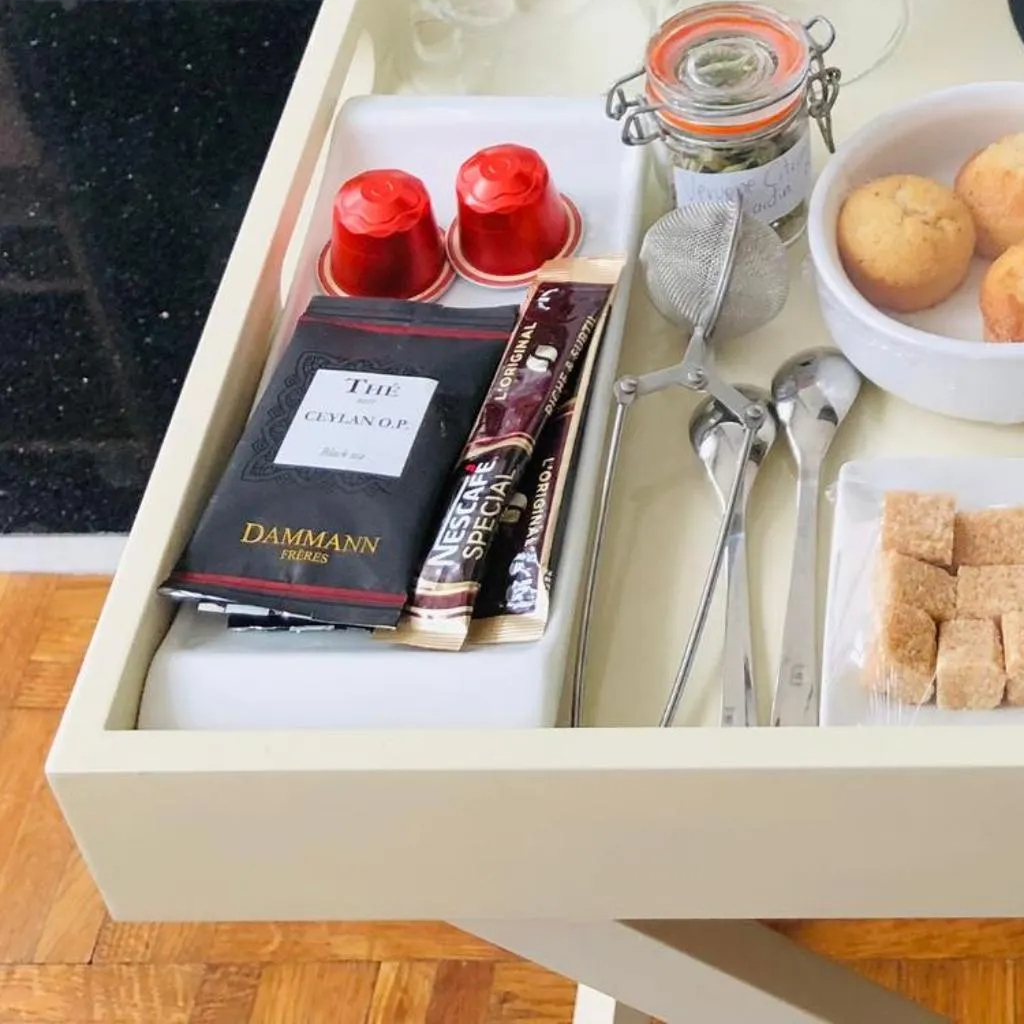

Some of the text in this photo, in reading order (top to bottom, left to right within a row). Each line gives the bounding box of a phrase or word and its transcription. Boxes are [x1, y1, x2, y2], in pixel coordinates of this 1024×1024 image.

[494, 321, 537, 401] L'ORIGINAL
[344, 377, 402, 398] THÉ
[304, 409, 411, 430] CEYLAN O.P.
[463, 468, 517, 561] SPECIAL
[240, 522, 381, 555] DAMMANN
